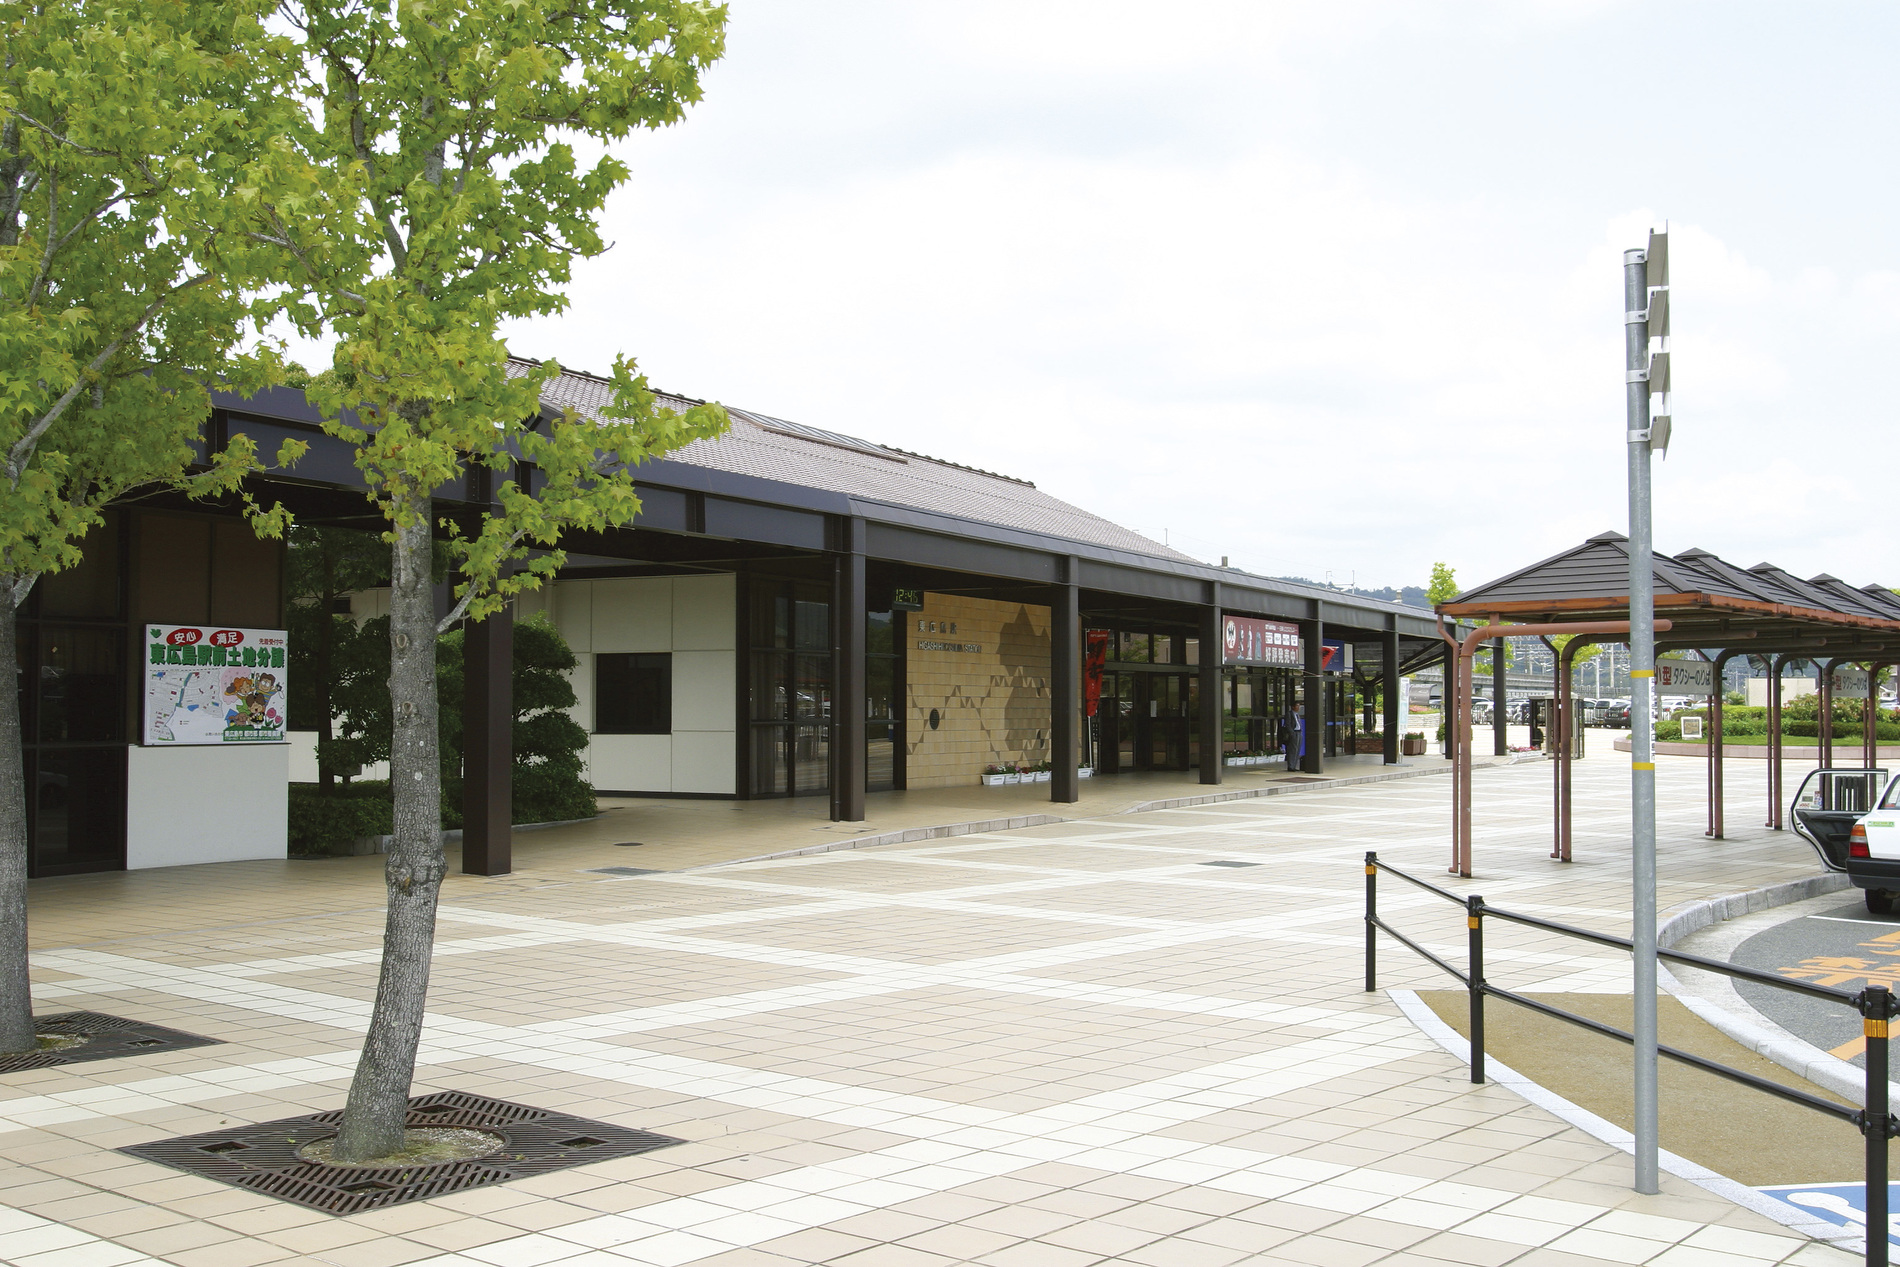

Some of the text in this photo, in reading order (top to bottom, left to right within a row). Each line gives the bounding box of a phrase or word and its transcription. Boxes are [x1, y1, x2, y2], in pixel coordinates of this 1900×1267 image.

[174, 631, 197, 644] 安心
[216, 631, 238, 645] 満足
[149, 643, 285, 668] 東広島駅前土地分譲
